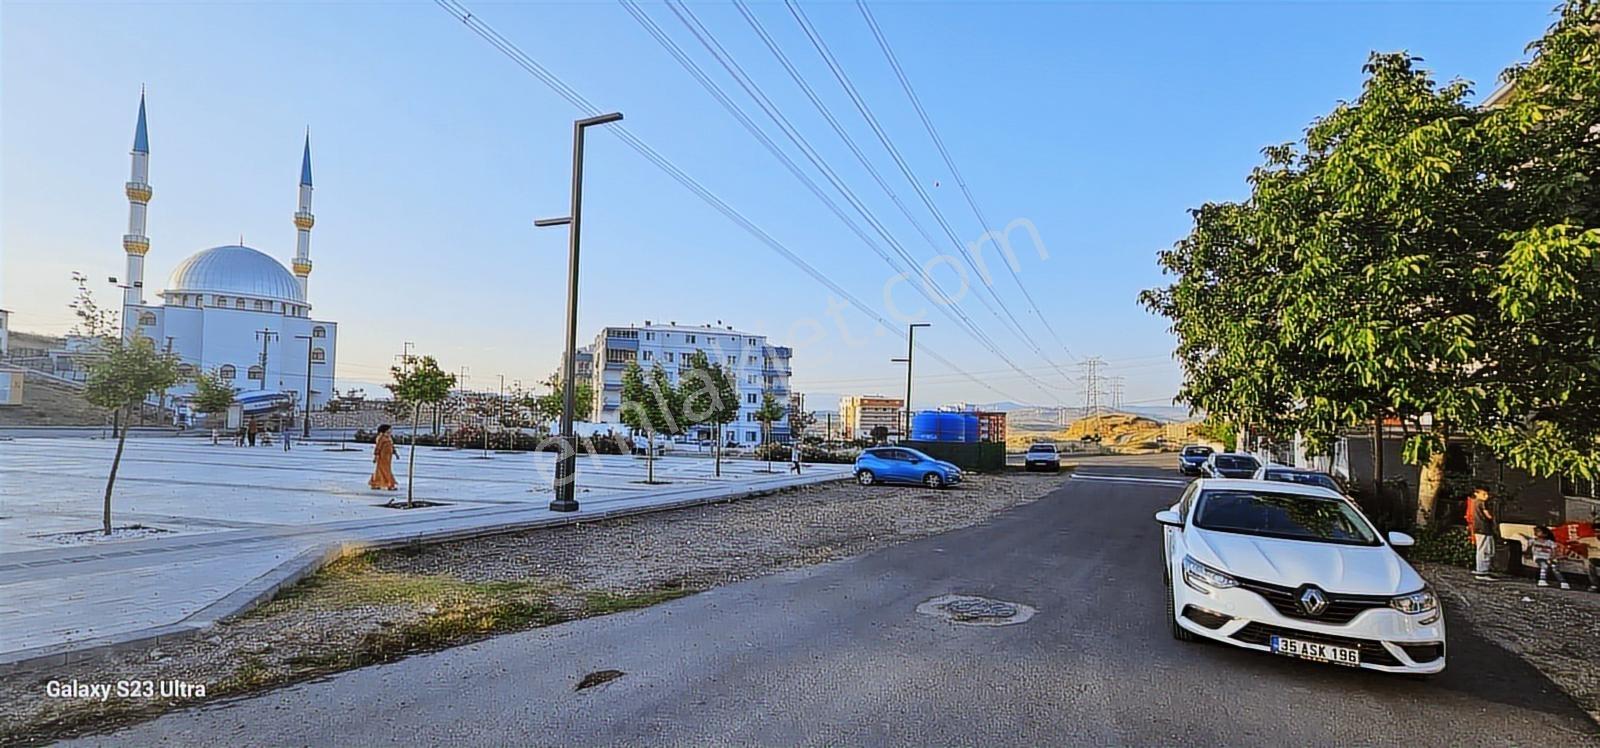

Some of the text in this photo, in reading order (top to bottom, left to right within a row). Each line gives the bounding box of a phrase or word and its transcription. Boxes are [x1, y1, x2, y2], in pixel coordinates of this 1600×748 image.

[1280, 639, 1297, 653] 35
[1301, 642, 1326, 658] ASK
[1332, 648, 1357, 662] 196
